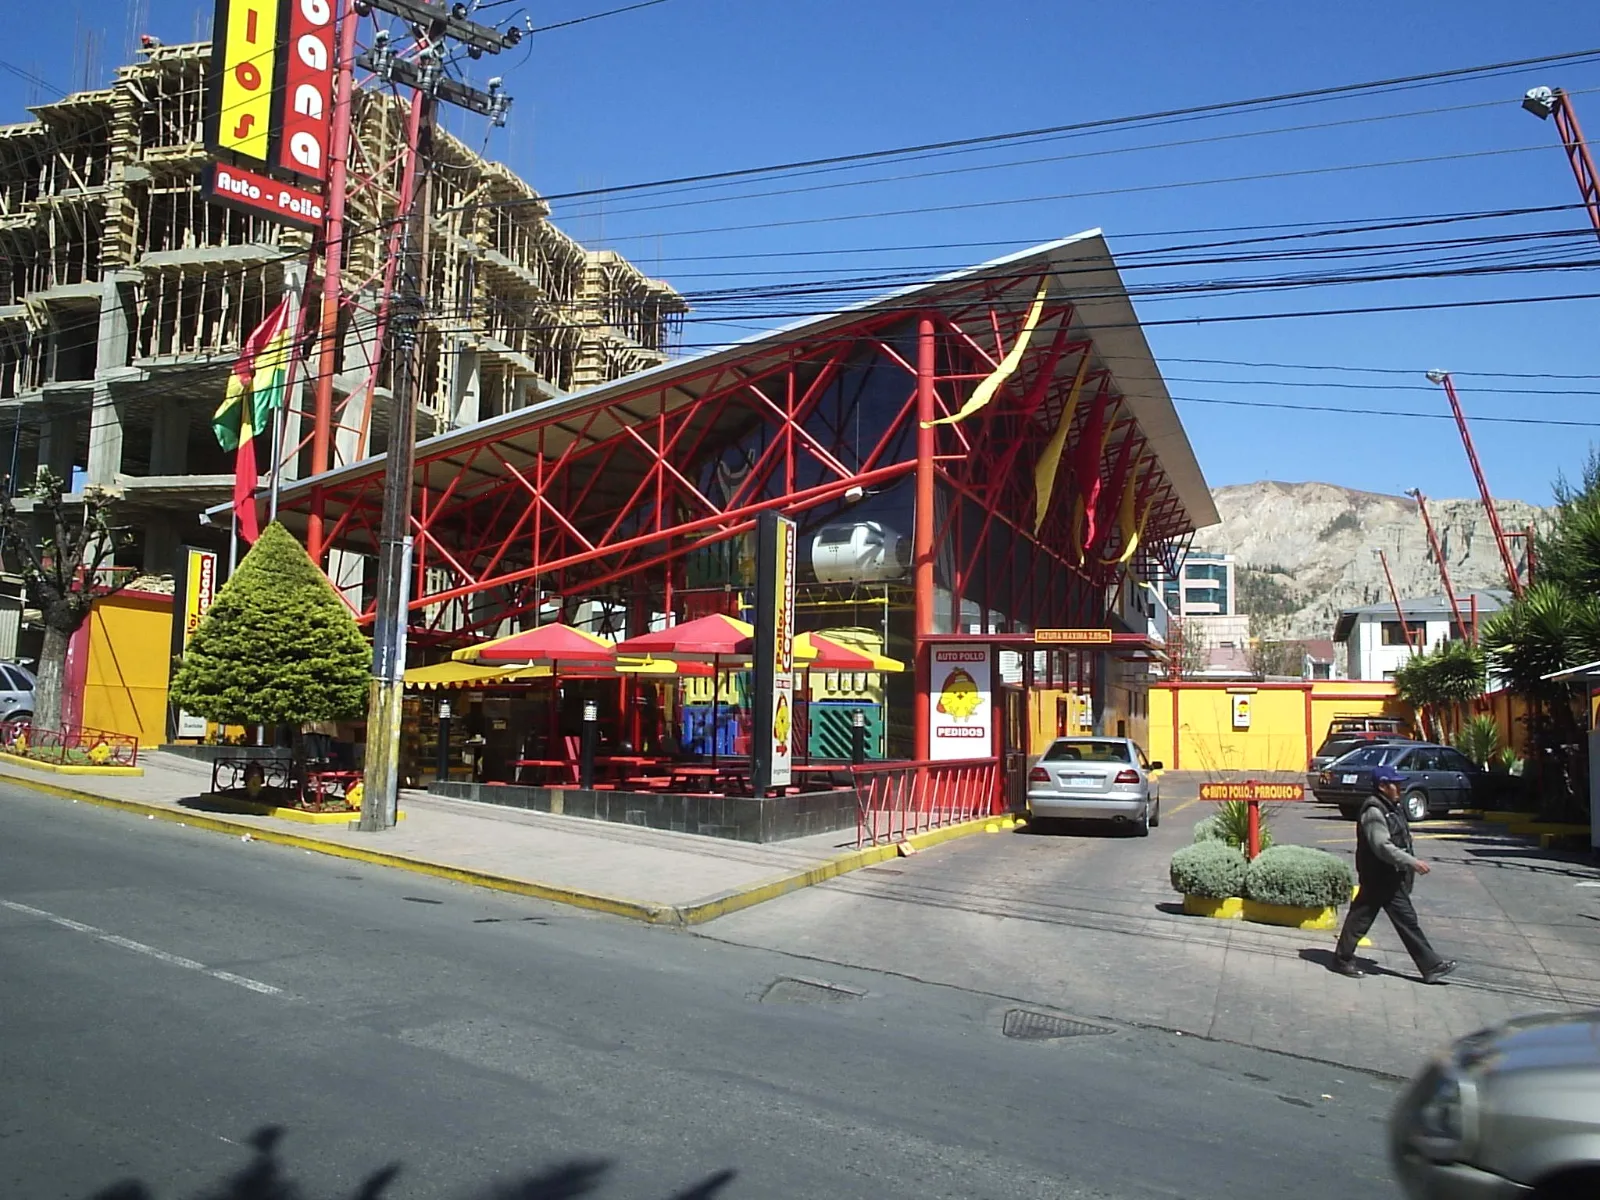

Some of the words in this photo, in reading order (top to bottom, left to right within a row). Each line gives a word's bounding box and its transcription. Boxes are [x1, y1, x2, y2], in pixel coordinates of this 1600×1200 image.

[217, 171, 261, 200] Auto
[278, 191, 322, 220] Pollo
[783, 529, 794, 669] Copacabana
[937, 652, 958, 660] AUTO
[959, 652, 984, 660] POLLO
[938, 728, 984, 737] PEDIDOS
[1210, 785, 1228, 798] AUTO
[1254, 785, 1293, 798] PARQUEO
